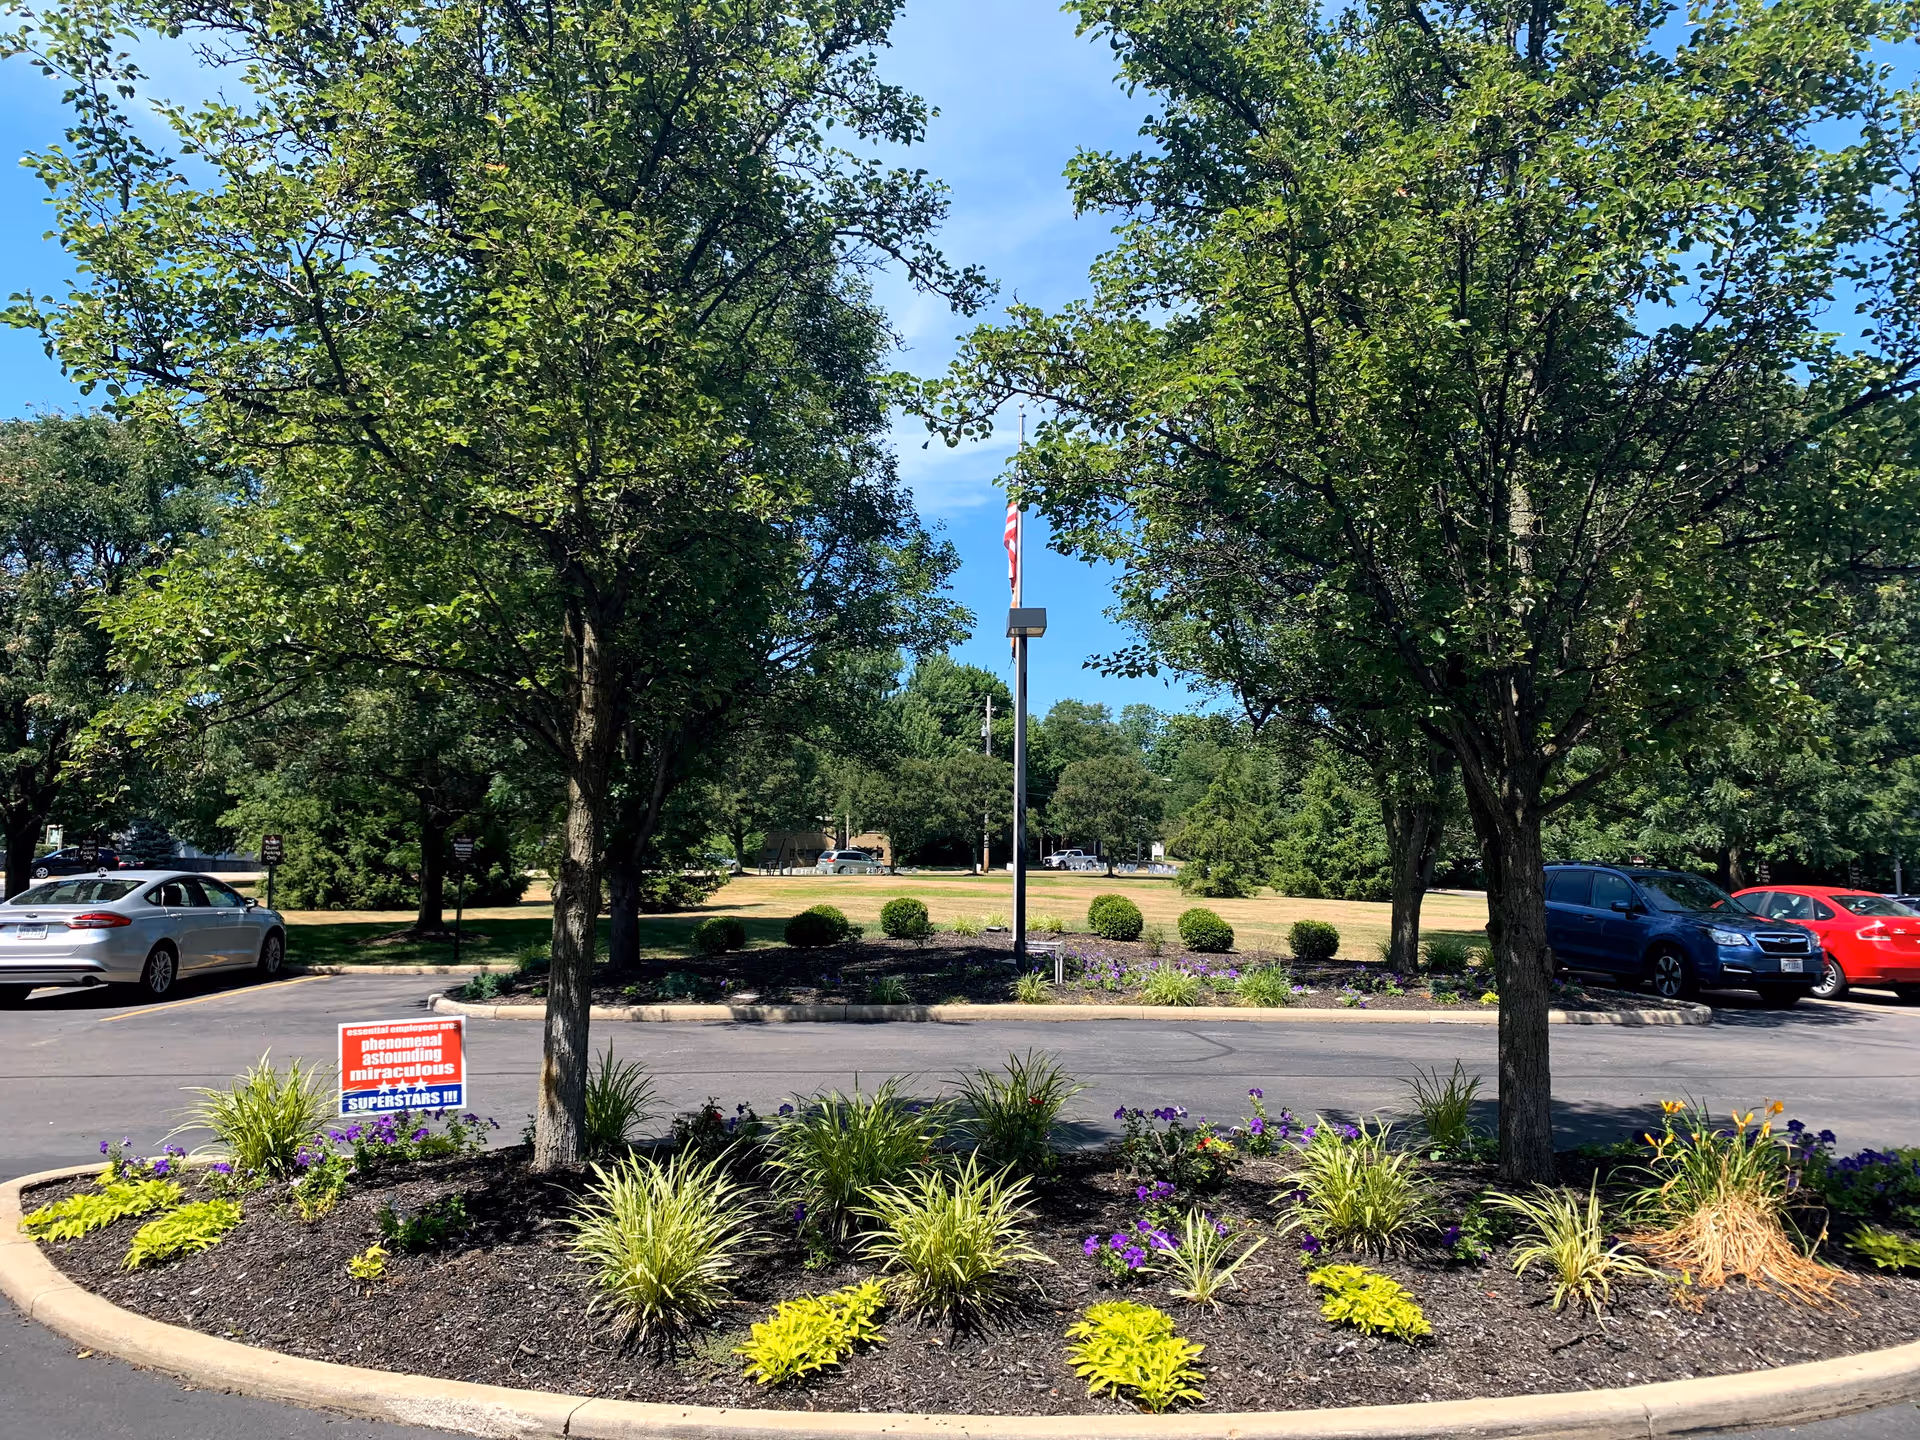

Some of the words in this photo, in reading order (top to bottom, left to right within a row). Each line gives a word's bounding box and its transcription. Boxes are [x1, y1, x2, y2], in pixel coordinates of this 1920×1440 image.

[346, 1026, 389, 1037] essential
[390, 1023, 439, 1034] employees
[361, 1033, 442, 1053] phenomenal
[362, 1048, 442, 1066] astounding
[349, 1063, 455, 1082] miraculous
[348, 1091, 440, 1111] SUPERSTARS
[443, 1090, 458, 1104] !!!
